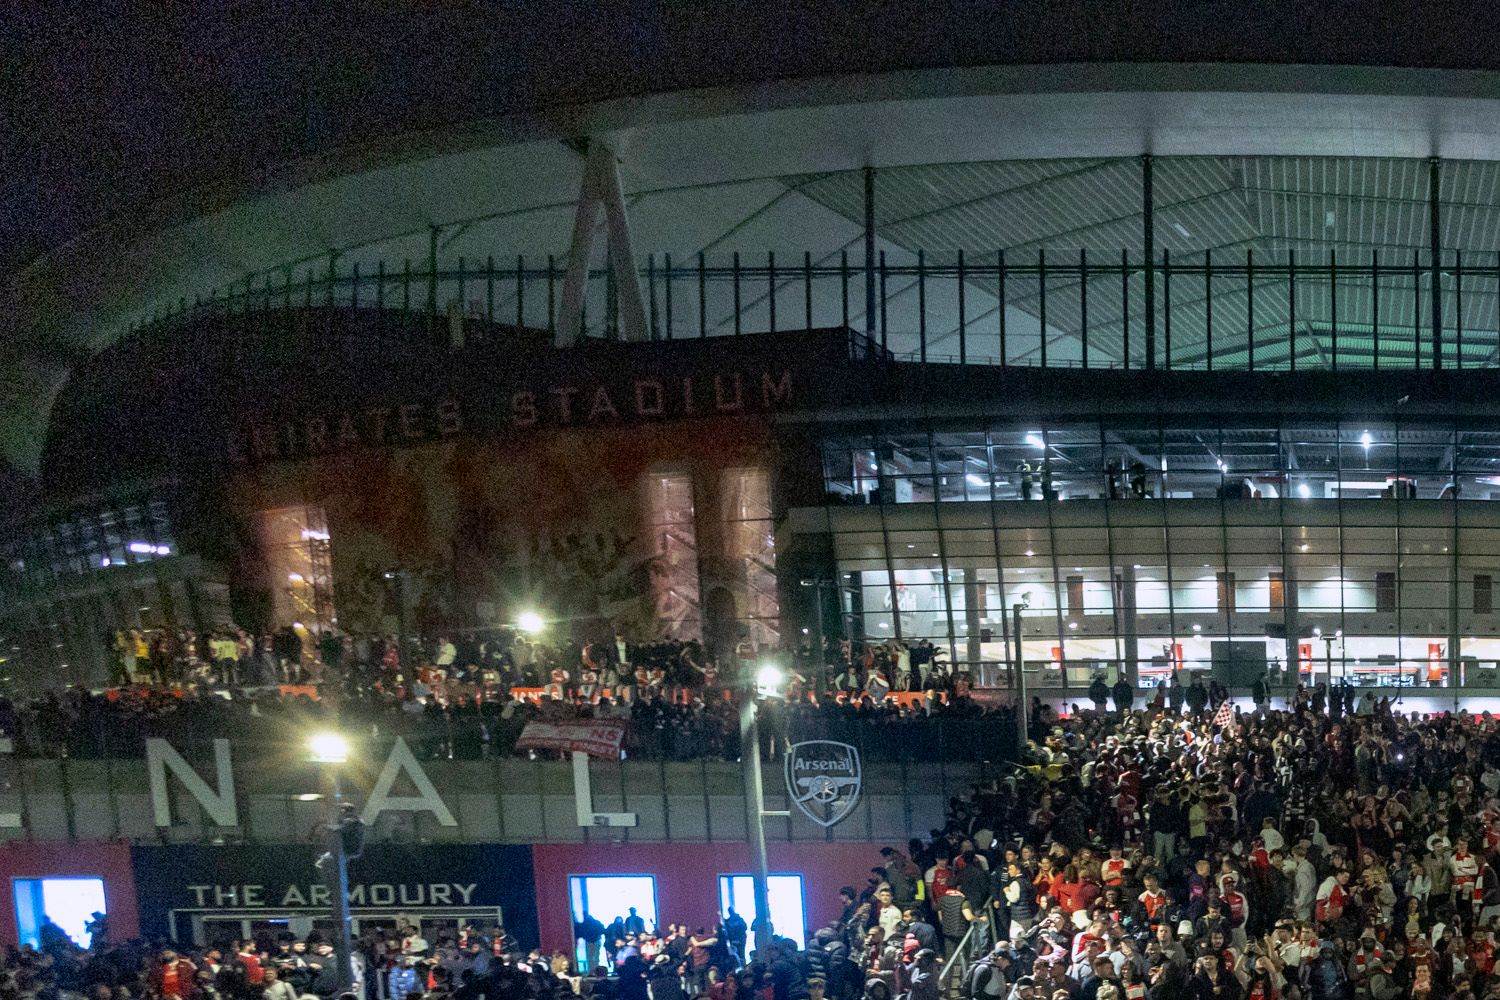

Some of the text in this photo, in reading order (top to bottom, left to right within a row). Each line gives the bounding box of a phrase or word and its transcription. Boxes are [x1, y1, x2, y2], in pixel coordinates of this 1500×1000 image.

[511, 368, 793, 427] STADIUM
[795, 757, 850, 771] Arsenal
[188, 884, 264, 906] THE
